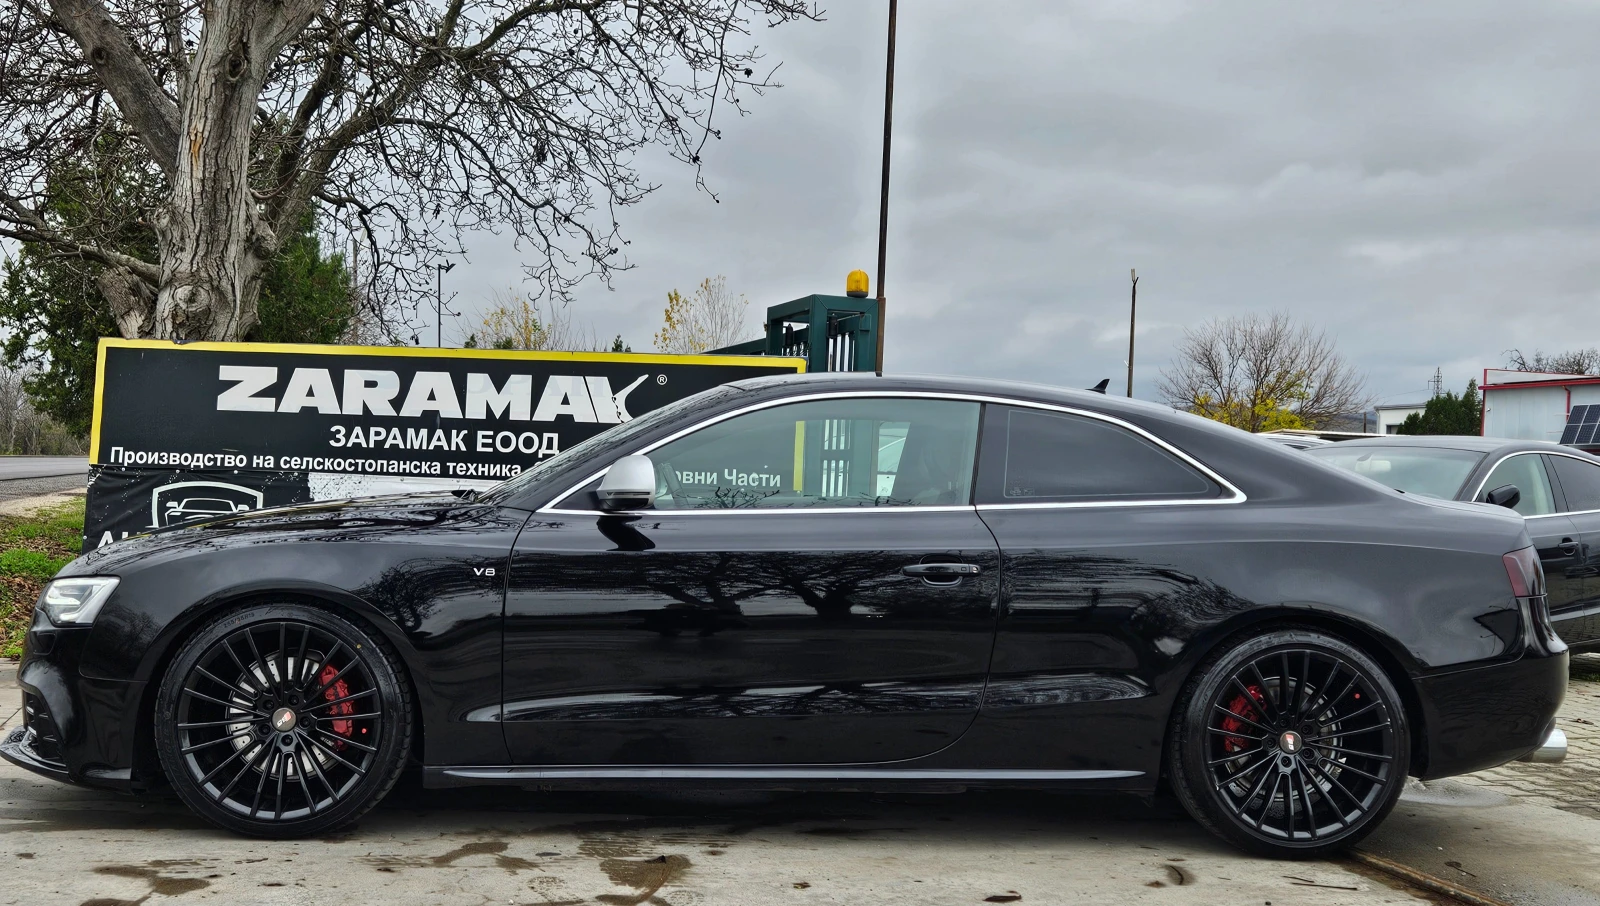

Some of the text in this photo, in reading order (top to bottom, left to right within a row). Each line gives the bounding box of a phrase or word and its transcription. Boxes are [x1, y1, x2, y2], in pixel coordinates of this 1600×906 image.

[217, 365, 649, 423] ZARAMAK
[329, 425, 560, 458] ЗАРАМАК ЕООД
[110, 446, 522, 477] Производство на селскостопанска техника
[724, 468, 781, 487] Части
[473, 567, 496, 576] V8
